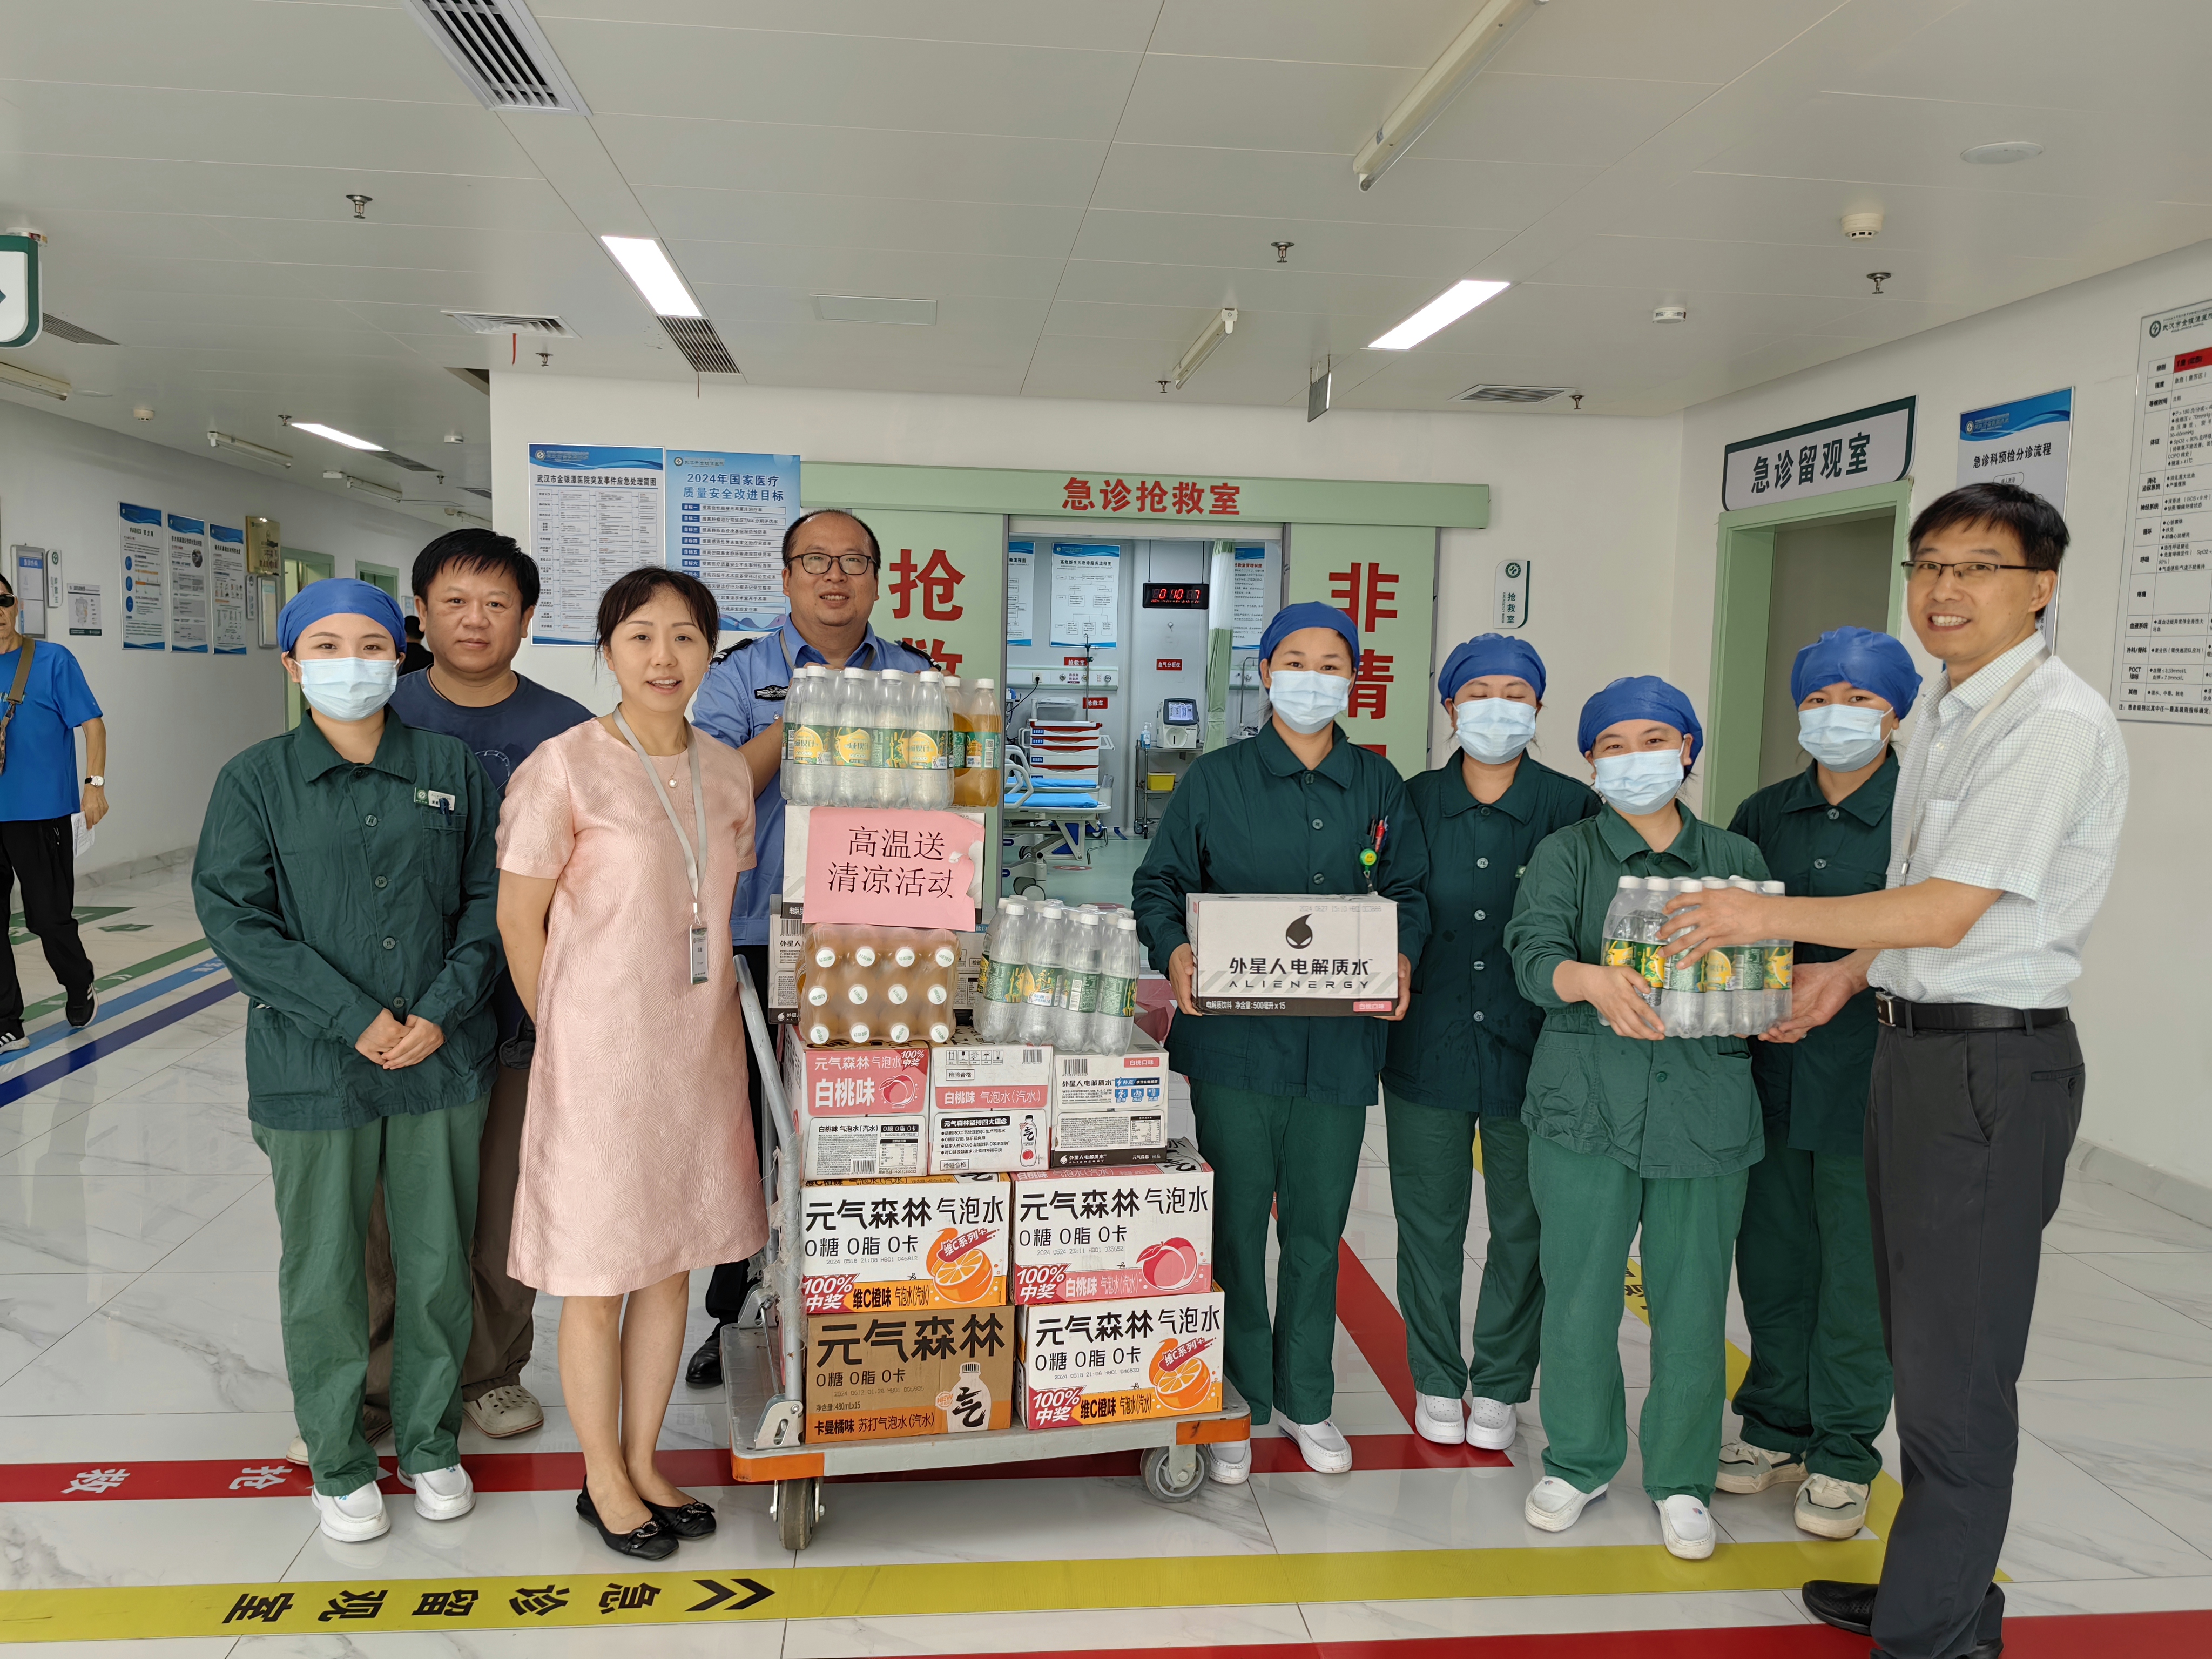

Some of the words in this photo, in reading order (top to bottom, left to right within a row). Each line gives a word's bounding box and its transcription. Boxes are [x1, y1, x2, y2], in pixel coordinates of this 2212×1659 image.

[1751, 432, 1870, 494] 急诊留观室
[1972, 442, 2052, 469] 急诊科预检分诊流程
[537, 474, 656, 486] 武汉市金银潭医院突发事件应急处理简图
[687, 473, 779, 487] 2024年国家医疗
[683, 487, 784, 501] 质量安全改进目标
[1062, 477, 1240, 515] 急诊抢救室
[1507, 592, 1516, 623] 抢救室
[848, 826, 945, 861] 高温送
[827, 861, 954, 899] 清凉活动
[1229, 957, 1369, 975] 外星人电解质水
[1229, 980, 1370, 989] ALIENERGY
[1206, 1001, 1232, 1009] 电解质饮料
[814, 1056, 870, 1070] 元气森林
[872, 1055, 901, 1069] 气泡水
[901, 1050, 924, 1058] 100%
[902, 1058, 920, 1067] 中奖
[815, 1077, 875, 1108] 白桃味
[945, 1091, 975, 1104] 白桃味
[944, 1118, 1008, 1127] 元气森林坚持四大理念
[806, 1197, 932, 1232] 元气森林
[936, 1196, 1004, 1225] 气泡水
[1020, 1188, 1141, 1222] 元气森林
[1145, 1186, 1208, 1215] 气泡水
[1019, 1229, 1051, 1246] 0糖
[1060, 1227, 1091, 1245] 0脂
[1098, 1225, 1127, 1242] 0卡
[805, 1238, 839, 1257] 0糖
[847, 1236, 880, 1255] 0脂
[888, 1235, 919, 1253] 0卡
[803, 1274, 852, 1294] 100%
[1017, 1266, 1065, 1285] 100%
[1020, 1284, 1057, 1303] 中奖
[1065, 1277, 1097, 1298] 白桃味
[806, 1293, 844, 1312] 中奖
[853, 1288, 891, 1309] 维C橙味
[1035, 1310, 1154, 1347] 元气森林
[1158, 1305, 1220, 1334] 气泡水
[816, 1313, 1005, 1368] 元气森林
[1035, 1352, 1067, 1371] 0糖
[1075, 1350, 1105, 1367] 0脂
[1112, 1346, 1141, 1364] 0卡
[816, 1372, 844, 1387] 0糖
[849, 1371, 875, 1385] 0脂
[881, 1368, 906, 1383] 0卡
[937, 1394, 953, 1404] NEW
[952, 1386, 986, 1427] 气
[1033, 1388, 1081, 1409] 100%
[1036, 1406, 1071, 1426] 中奖
[1080, 1399, 1116, 1419] 维C橙味
[814, 1419, 854, 1435] 卡曼橘味
[222, 1583, 662, 1623] 急诊留观室
